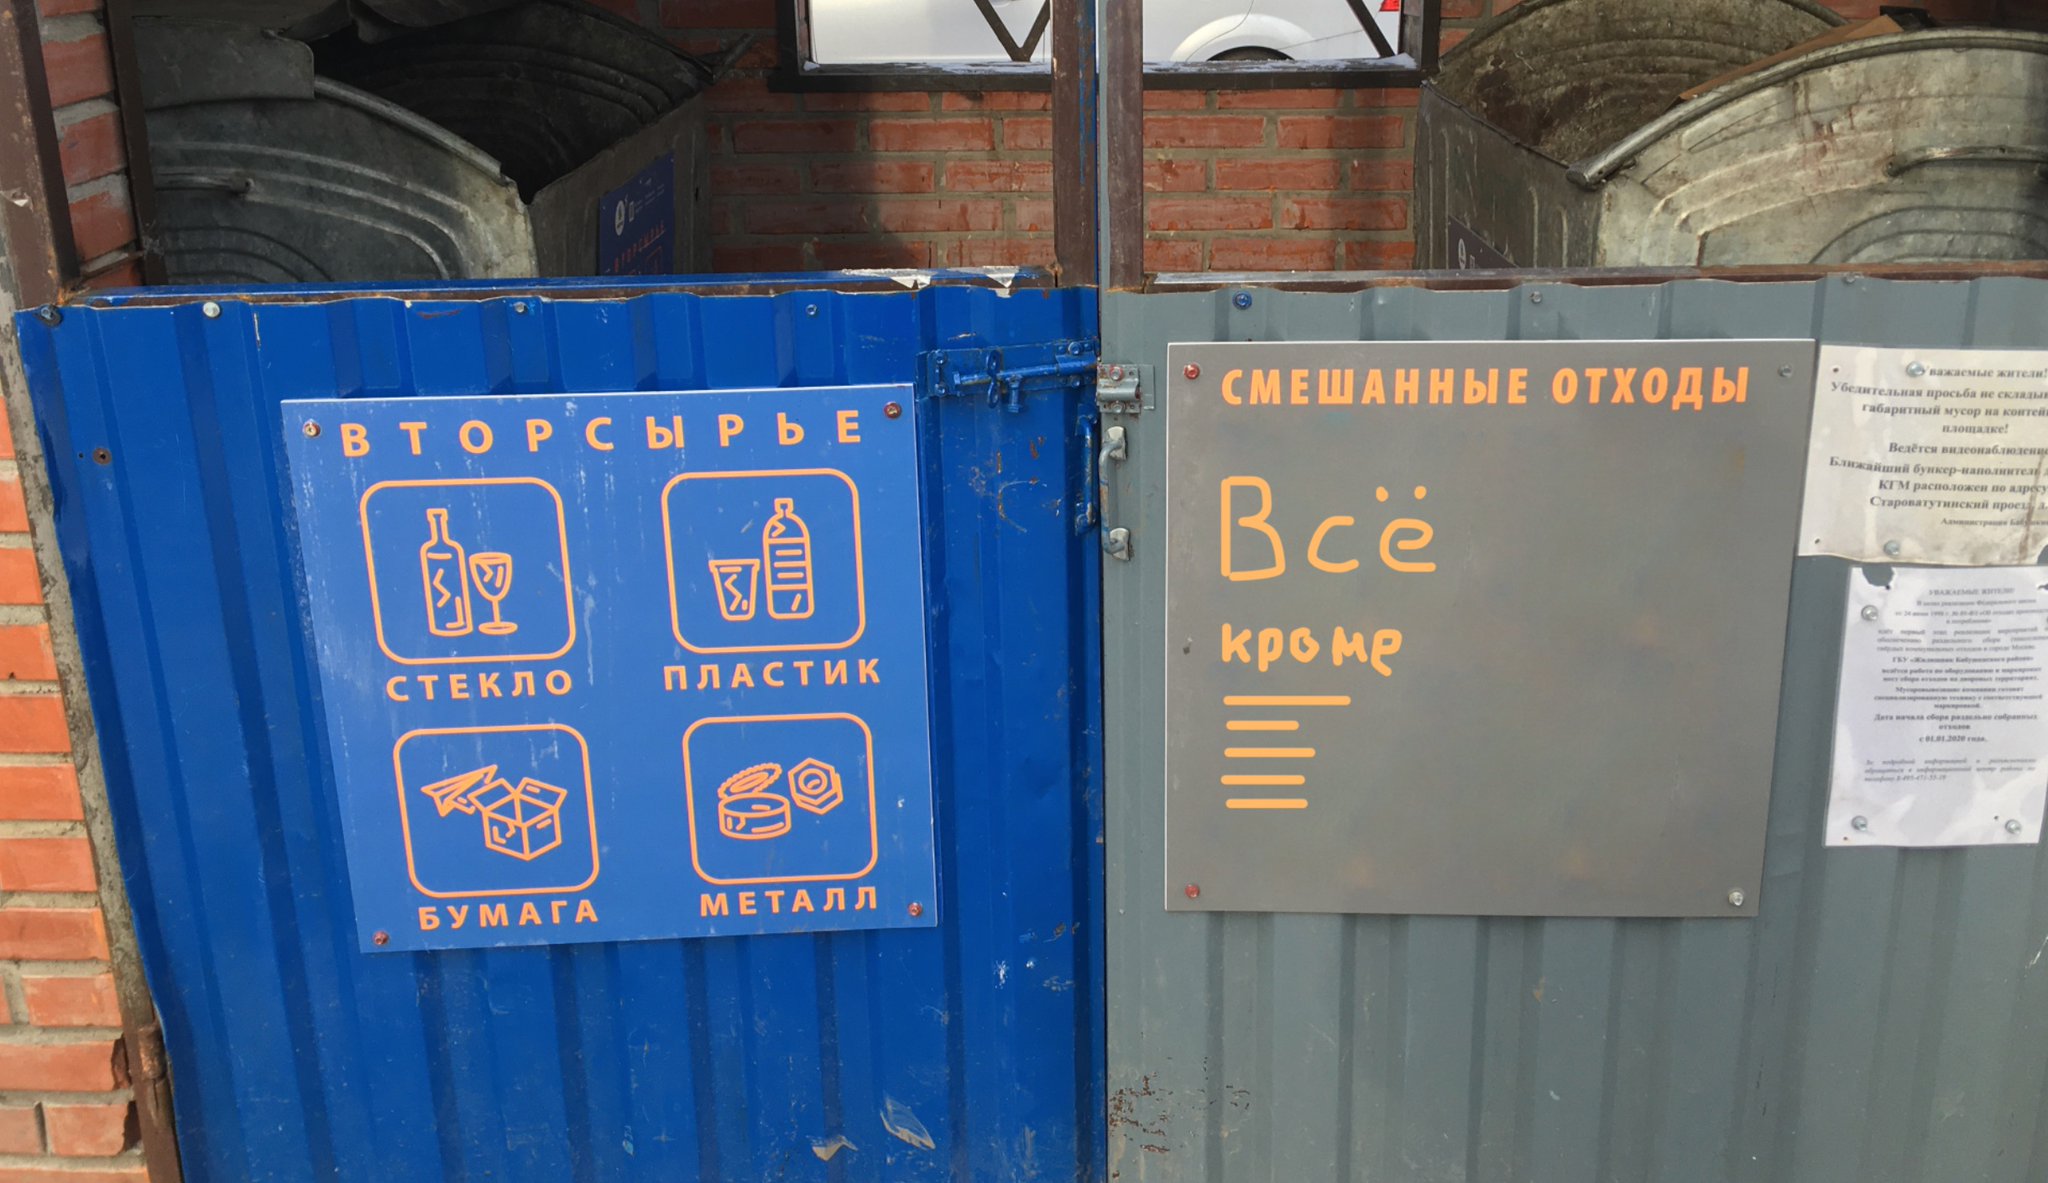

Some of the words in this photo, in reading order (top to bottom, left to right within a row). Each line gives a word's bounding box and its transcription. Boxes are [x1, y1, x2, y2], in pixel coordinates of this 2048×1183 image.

[1925, 366, 1995, 378] важаемые
[1221, 367, 1528, 406] СМЕШАННЫЕ
[1551, 366, 1749, 411] ОТХОДЫ
[1831, 381, 1923, 398] Убедительная
[1926, 387, 1977, 399] просьба
[1980, 390, 1995, 399] не
[1862, 402, 1941, 416] габаритный
[1943, 405, 1982, 418] мусор
[1984, 408, 1999, 417] на
[340, 410, 861, 457] ВТОРСЫРЬЕ
[1942, 423, 2009, 435] площадке!
[1888, 441, 1938, 454] Ведётся
[1829, 456, 1910, 474] Ближайший
[1878, 479, 1910, 490] КГМ
[1913, 481, 1988, 493] расположен
[1991, 484, 2006, 493] по
[1869, 495, 1989, 510] Староватутинский
[663, 658, 880, 691] ПЛАСТИК
[386, 669, 572, 702] СТЕКЛО
[699, 886, 877, 917] МЕТАЛЛ
[418, 899, 598, 931] БУМАГА
